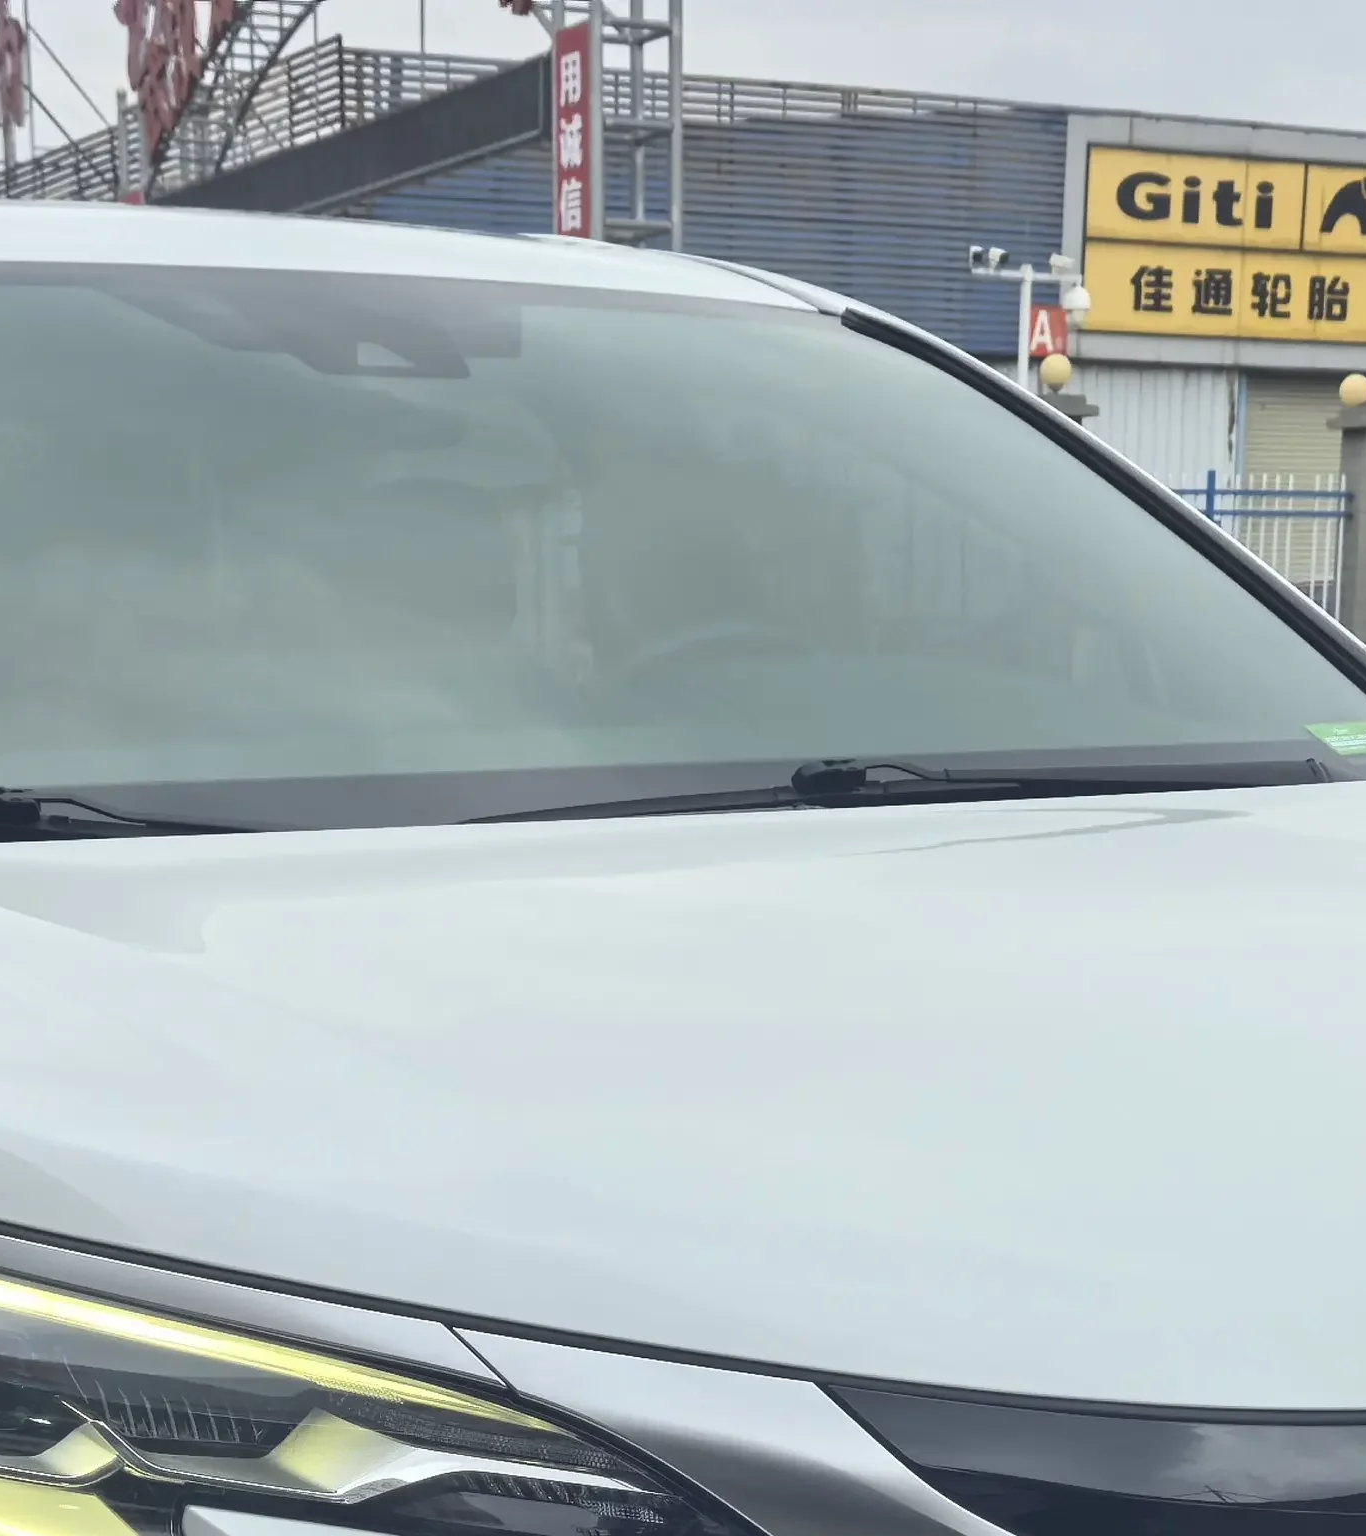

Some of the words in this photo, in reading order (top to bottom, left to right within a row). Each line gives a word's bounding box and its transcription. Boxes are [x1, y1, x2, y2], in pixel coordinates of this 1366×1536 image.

[1115, 171, 1275, 229] Giti
[1129, 263, 1351, 322] 佳通轮胎
